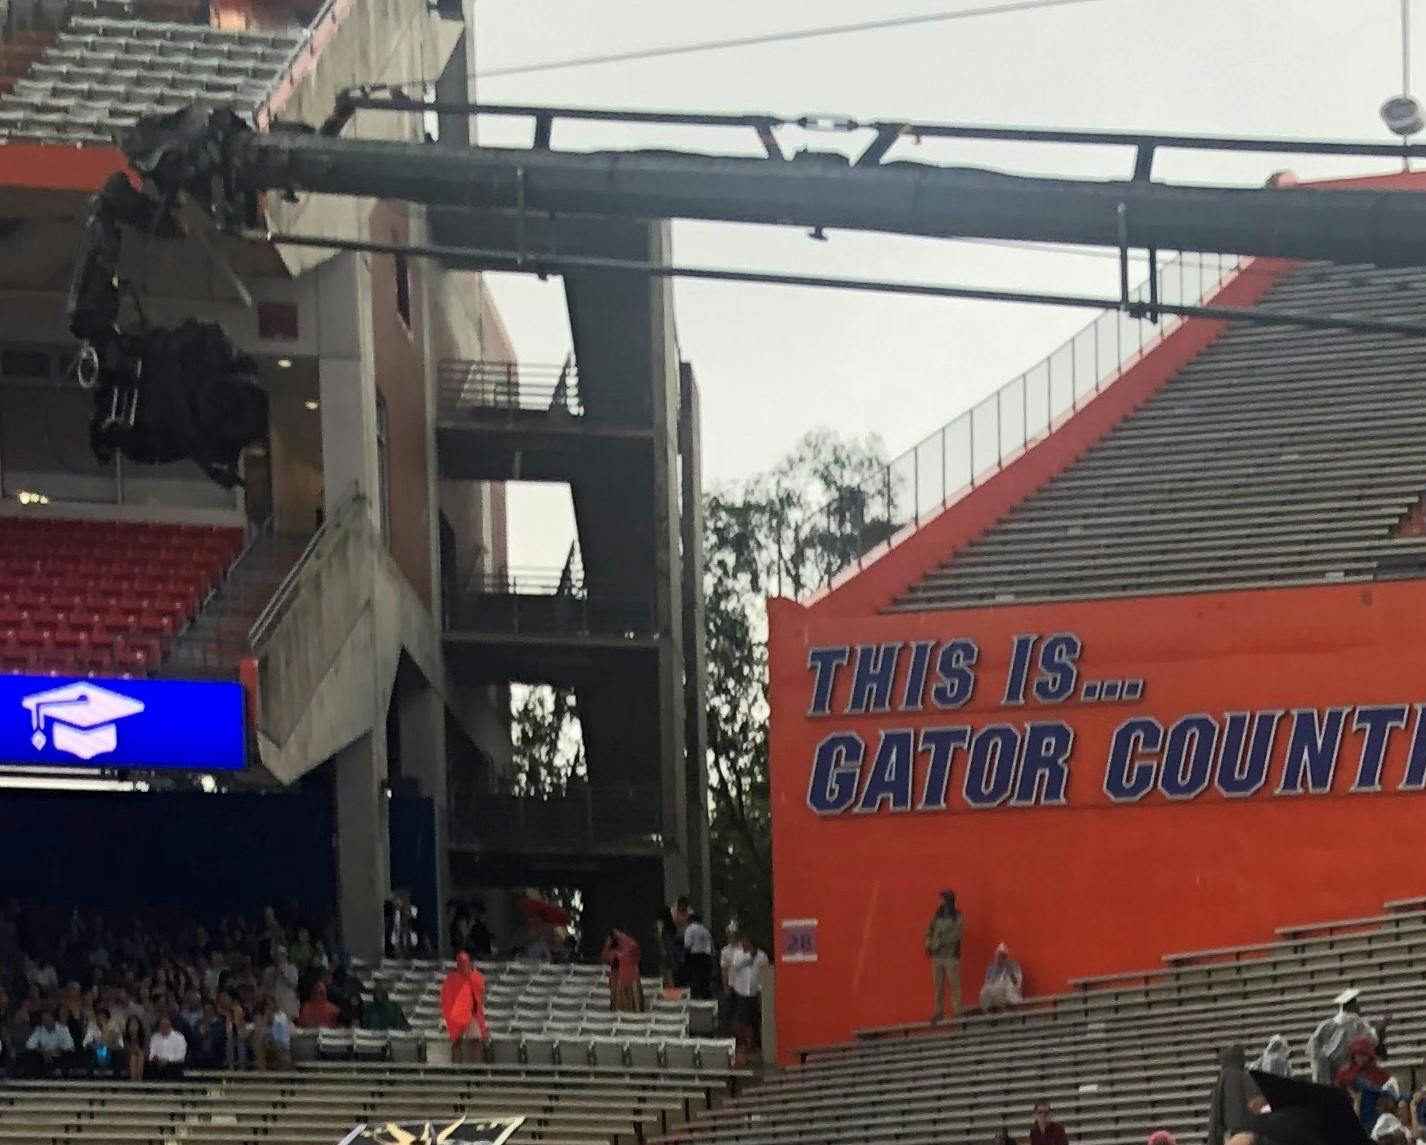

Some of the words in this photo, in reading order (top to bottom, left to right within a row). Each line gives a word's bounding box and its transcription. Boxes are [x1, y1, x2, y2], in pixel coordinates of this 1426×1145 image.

[806, 638, 979, 717] THIS
[1001, 632, 1144, 706] IS...
[806, 720, 1075, 816] GATOR
